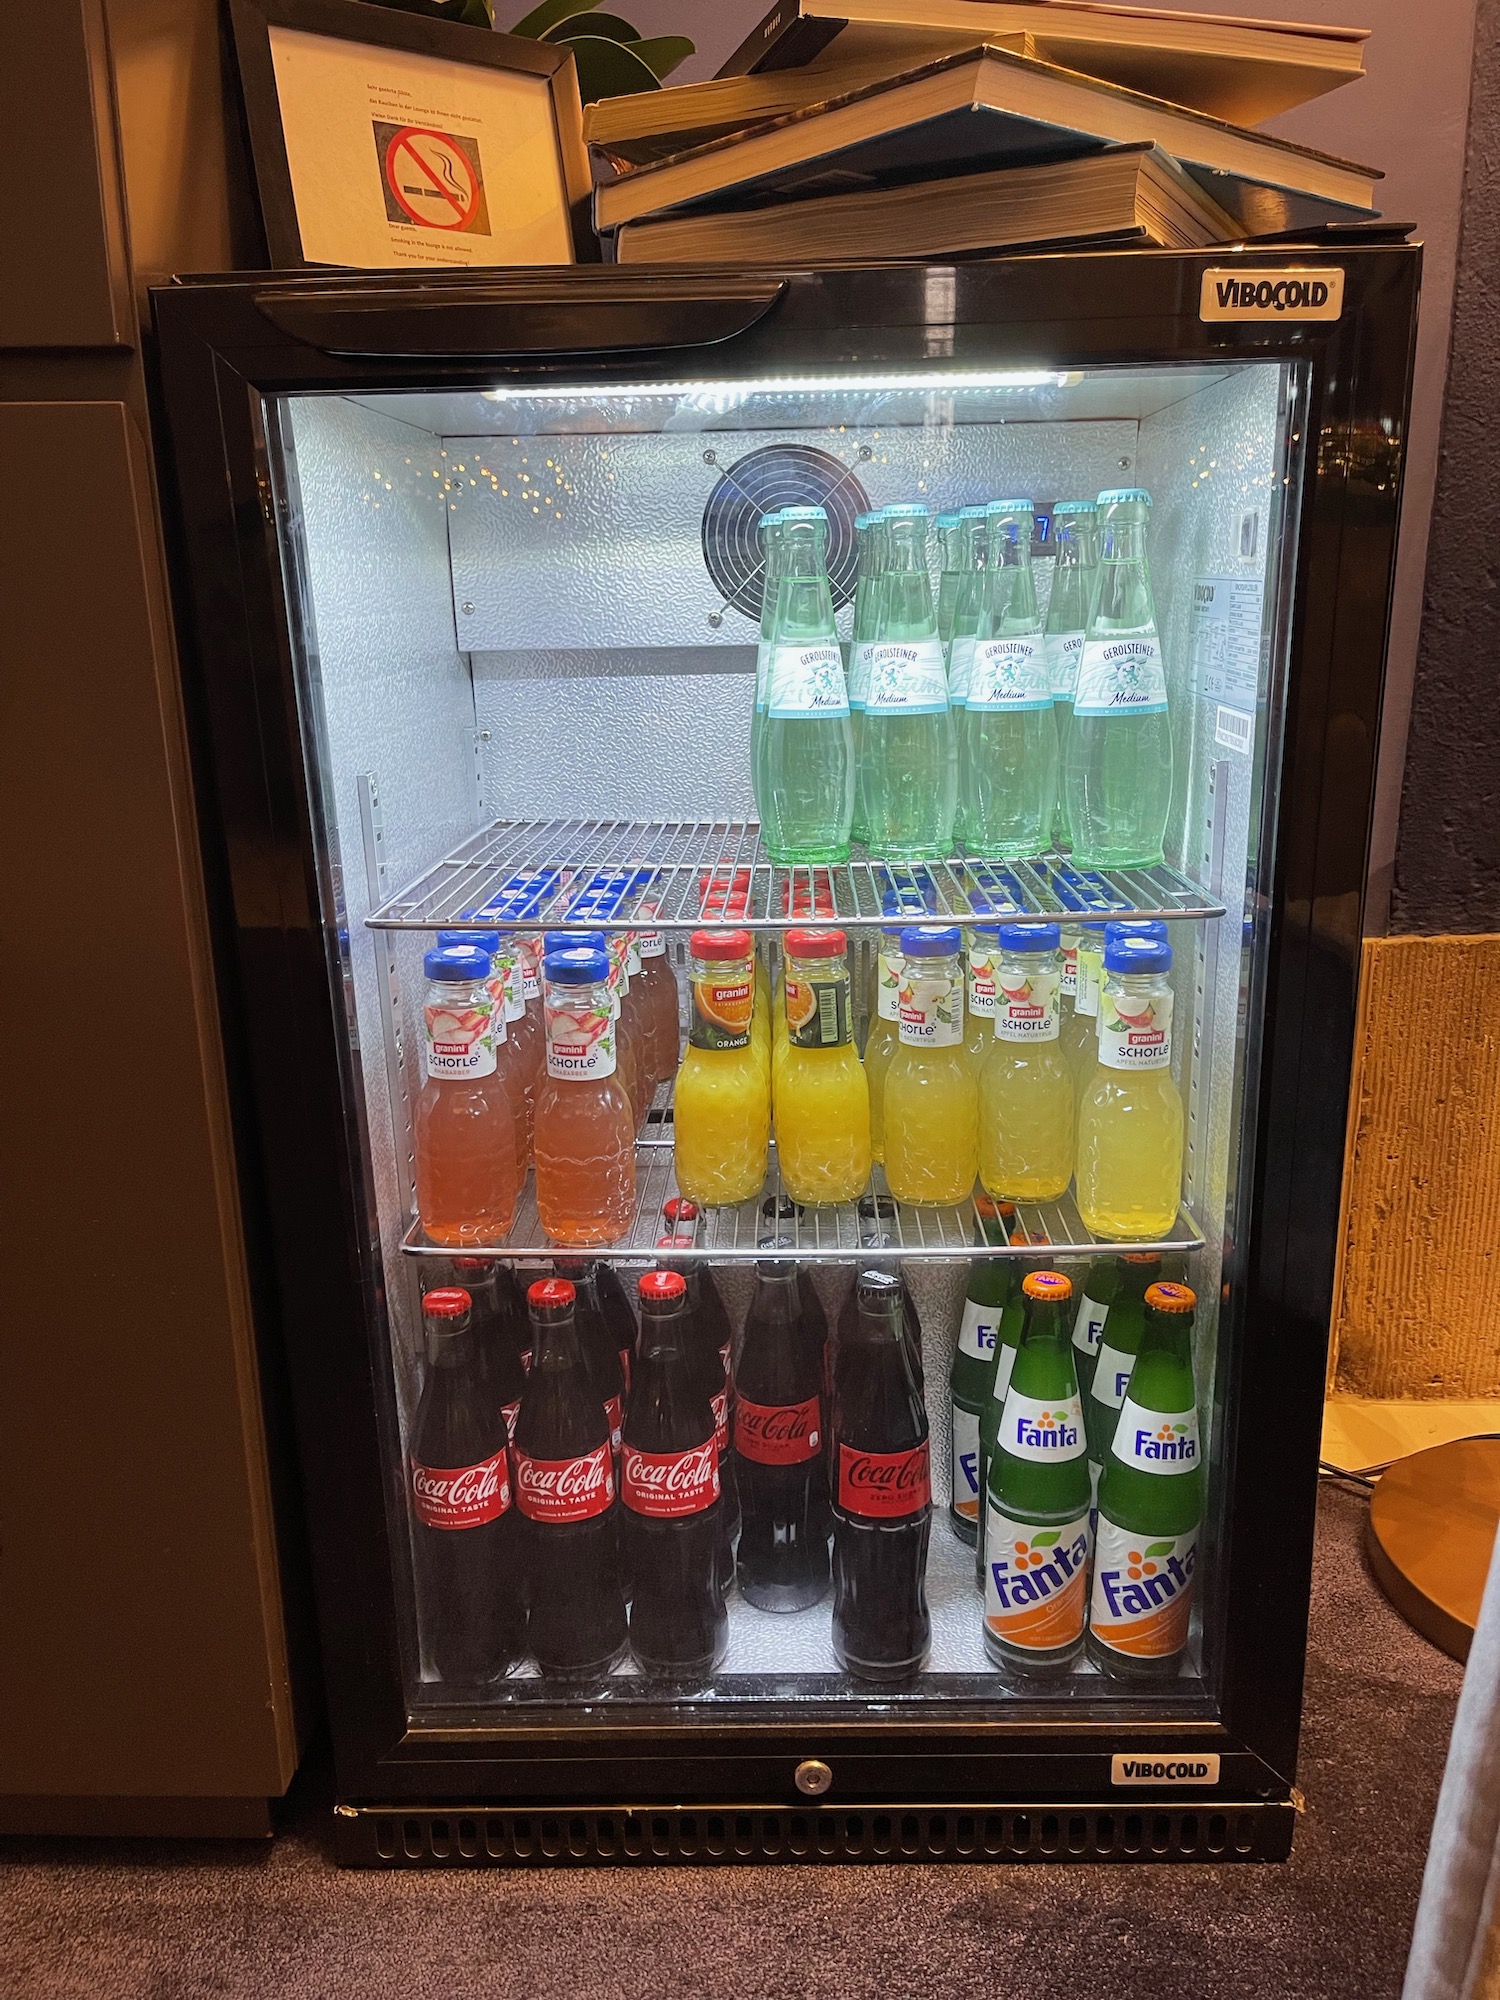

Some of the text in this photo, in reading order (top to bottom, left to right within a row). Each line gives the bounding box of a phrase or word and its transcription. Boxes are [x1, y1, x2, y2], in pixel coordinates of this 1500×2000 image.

[985, 643, 1034, 659] GEROLSTEINER
[874, 693, 909, 705] Medium
[988, 689, 1027, 702] Medium
[1109, 692, 1151, 707] Medium
[809, 696, 842, 709] Medium
[716, 987, 749, 1000] granini
[1012, 1008, 1041, 1017] granini
[717, 1037, 748, 1049] ORANGE
[1132, 1034, 1162, 1045] granini
[435, 1045, 465, 1054] granini
[554, 1046, 583, 1054] granini
[1017, 1418, 1077, 1448] Fanta
[1135, 1430, 1195, 1460] Fanta
[518, 1451, 605, 1497] Coca-Cola
[626, 1444, 711, 1492] Coca-Cola
[413, 1458, 500, 1506] Coca-Cola
[528, 1493, 596, 1506] ORIGINAL TASTE
[636, 1487, 704, 1500] ORIGINAL TASTE
[422, 1501, 489, 1514] ORIGINAL TASTE
[992, 1533, 1087, 1609] Fanta
[1101, 1542, 1196, 1618] Fanta
[1122, 1761, 1209, 1780] VIBOCOLD
